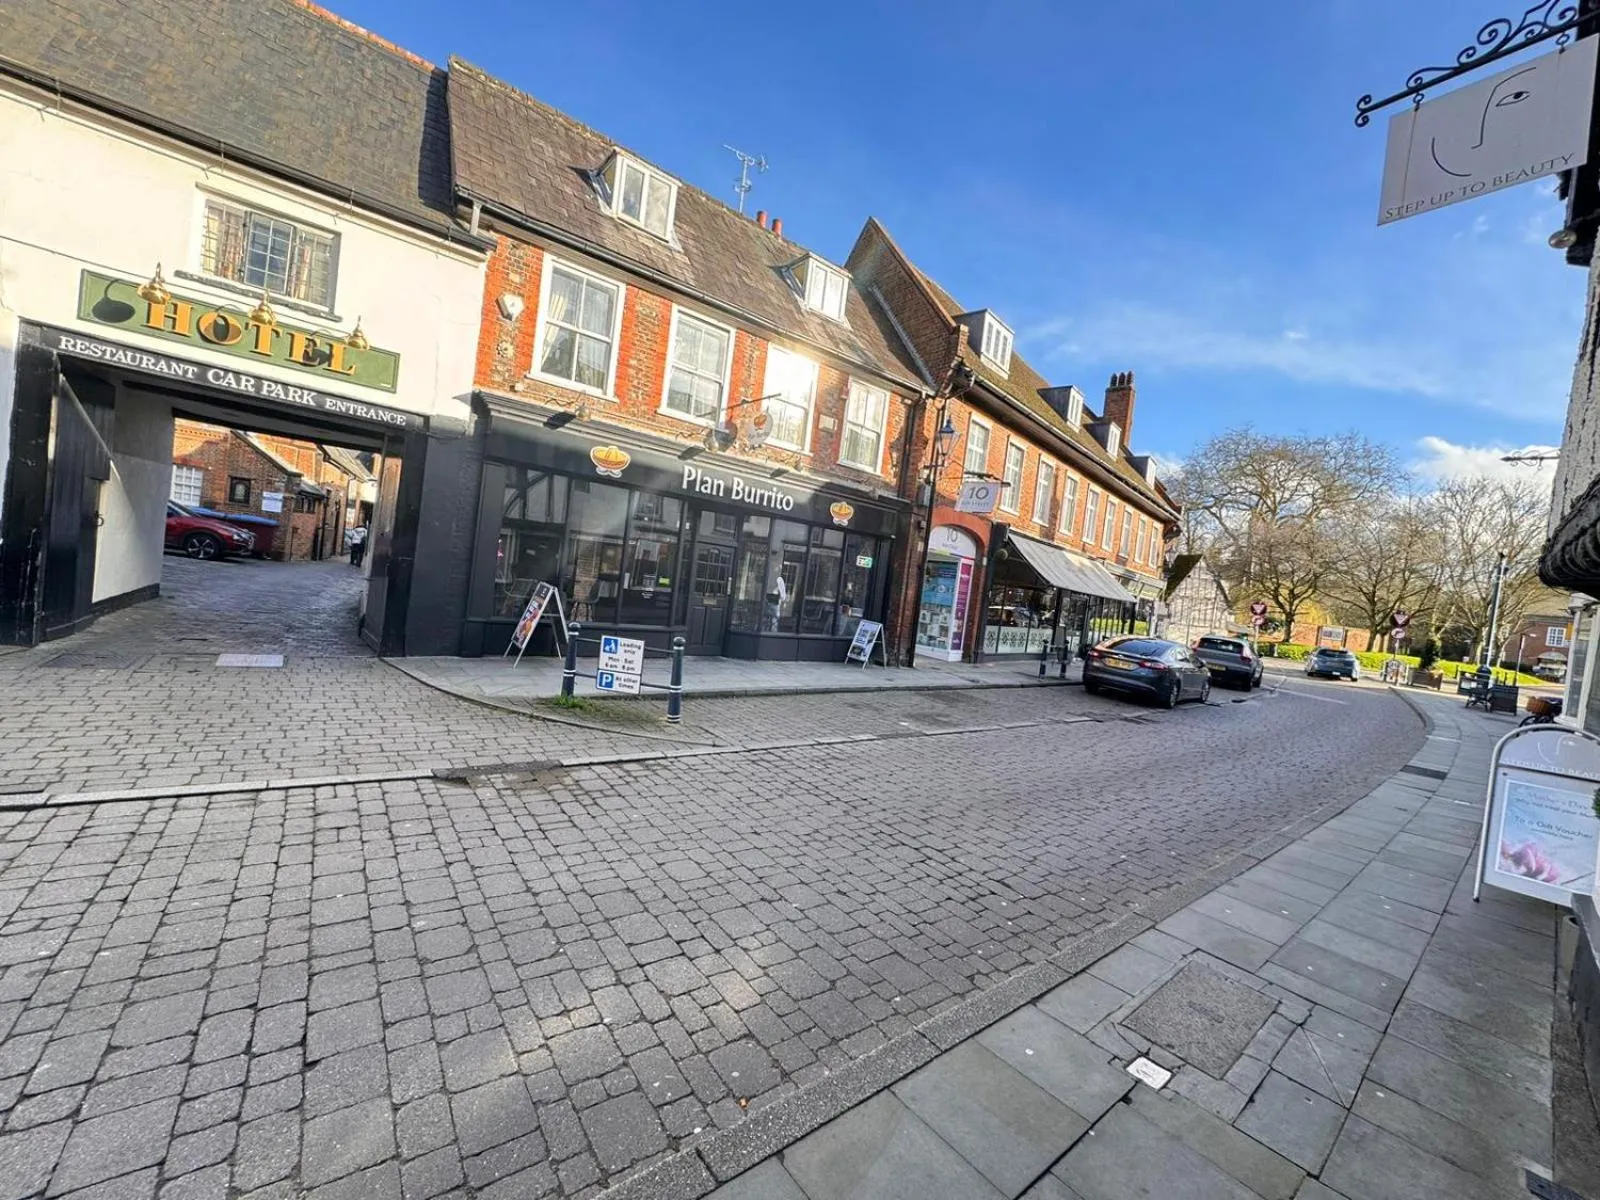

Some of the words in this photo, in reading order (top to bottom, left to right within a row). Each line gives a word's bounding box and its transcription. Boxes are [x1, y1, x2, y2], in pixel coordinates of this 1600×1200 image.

[1385, 199, 1425, 220] STEP
[1430, 191, 1455, 206] UP
[1458, 180, 1486, 197] TO
[1492, 151, 1575, 188] BEAUTY
[142, 299, 356, 377] HOTEL
[58, 335, 198, 379] RESTAURANT
[207, 367, 256, 393] CAR
[259, 379, 318, 407] PARK
[323, 397, 408, 427] ENTRANCE
[681, 464, 725, 497] Plan
[731, 476, 795, 511] Burrito
[967, 486, 990, 500] 10
[620, 641, 641, 650] Loading
[602, 674, 612, 686] P
[1555, 824, 1594, 839] Voucher
